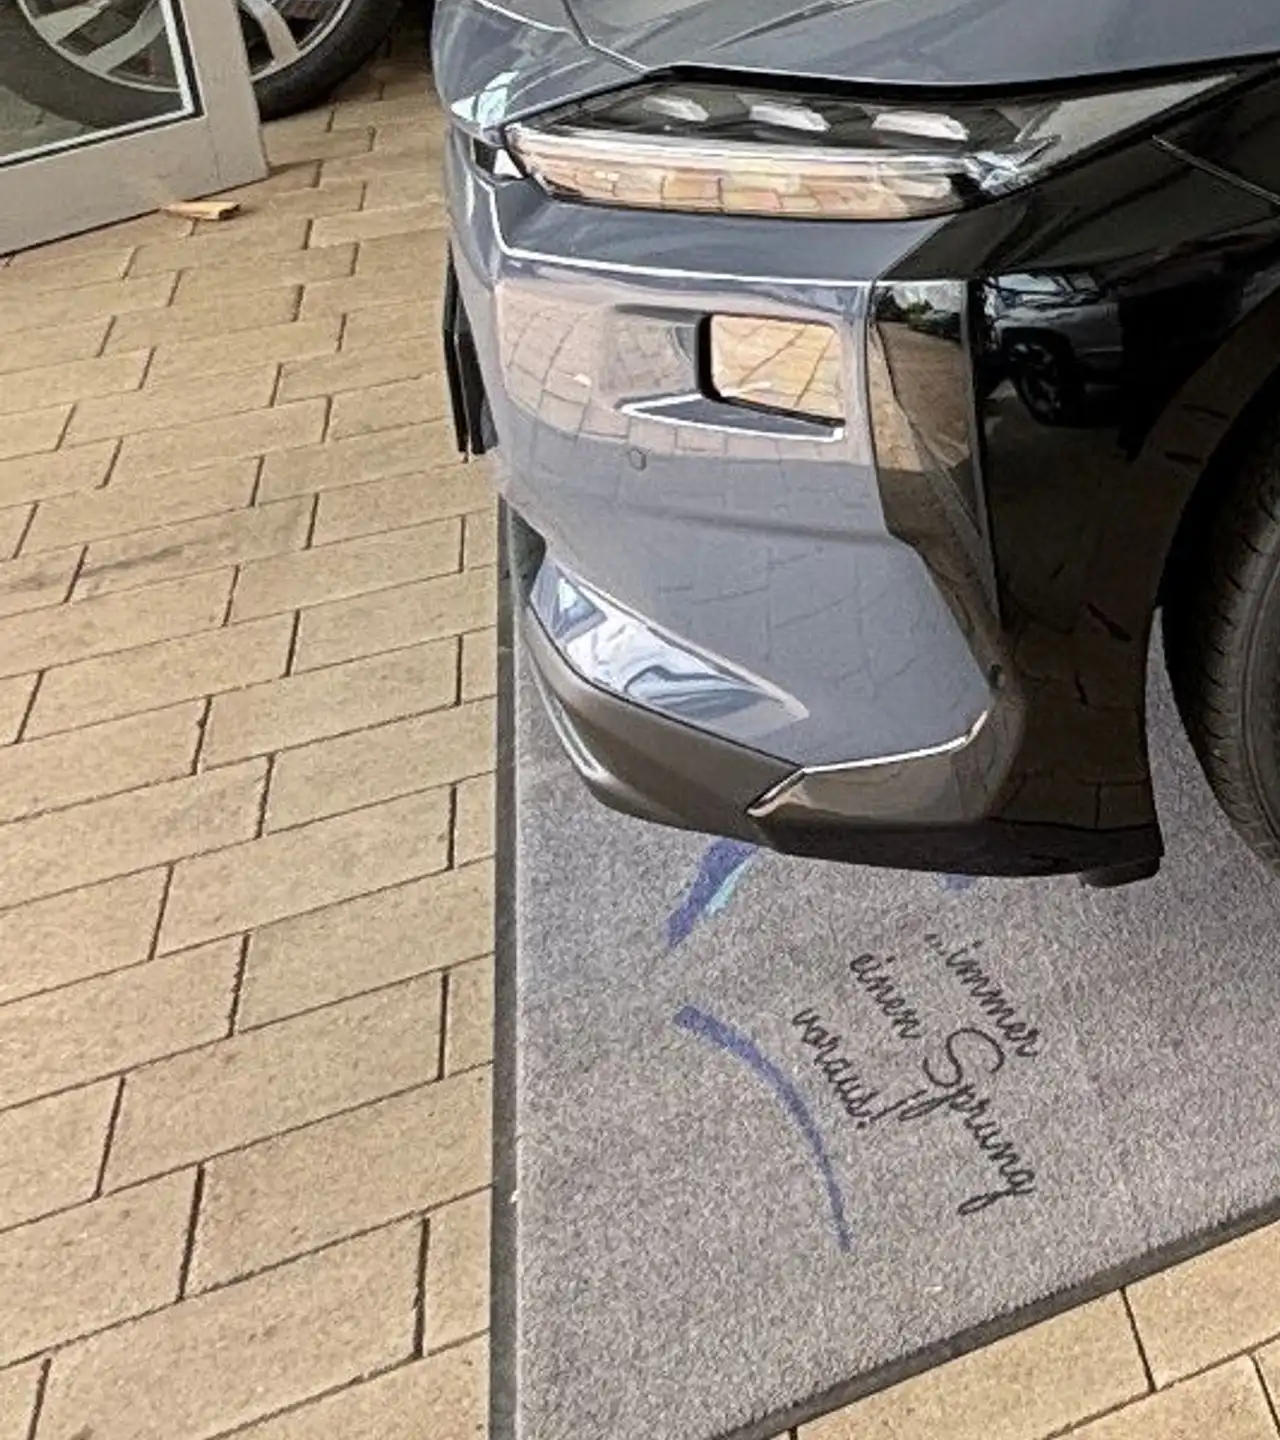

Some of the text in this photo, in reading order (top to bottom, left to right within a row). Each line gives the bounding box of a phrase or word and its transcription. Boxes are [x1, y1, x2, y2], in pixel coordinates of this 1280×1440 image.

[850, 952, 922, 1040] einen
[791, 1008, 929, 1130] voraus!
[898, 1026, 1037, 1216] Sprung
